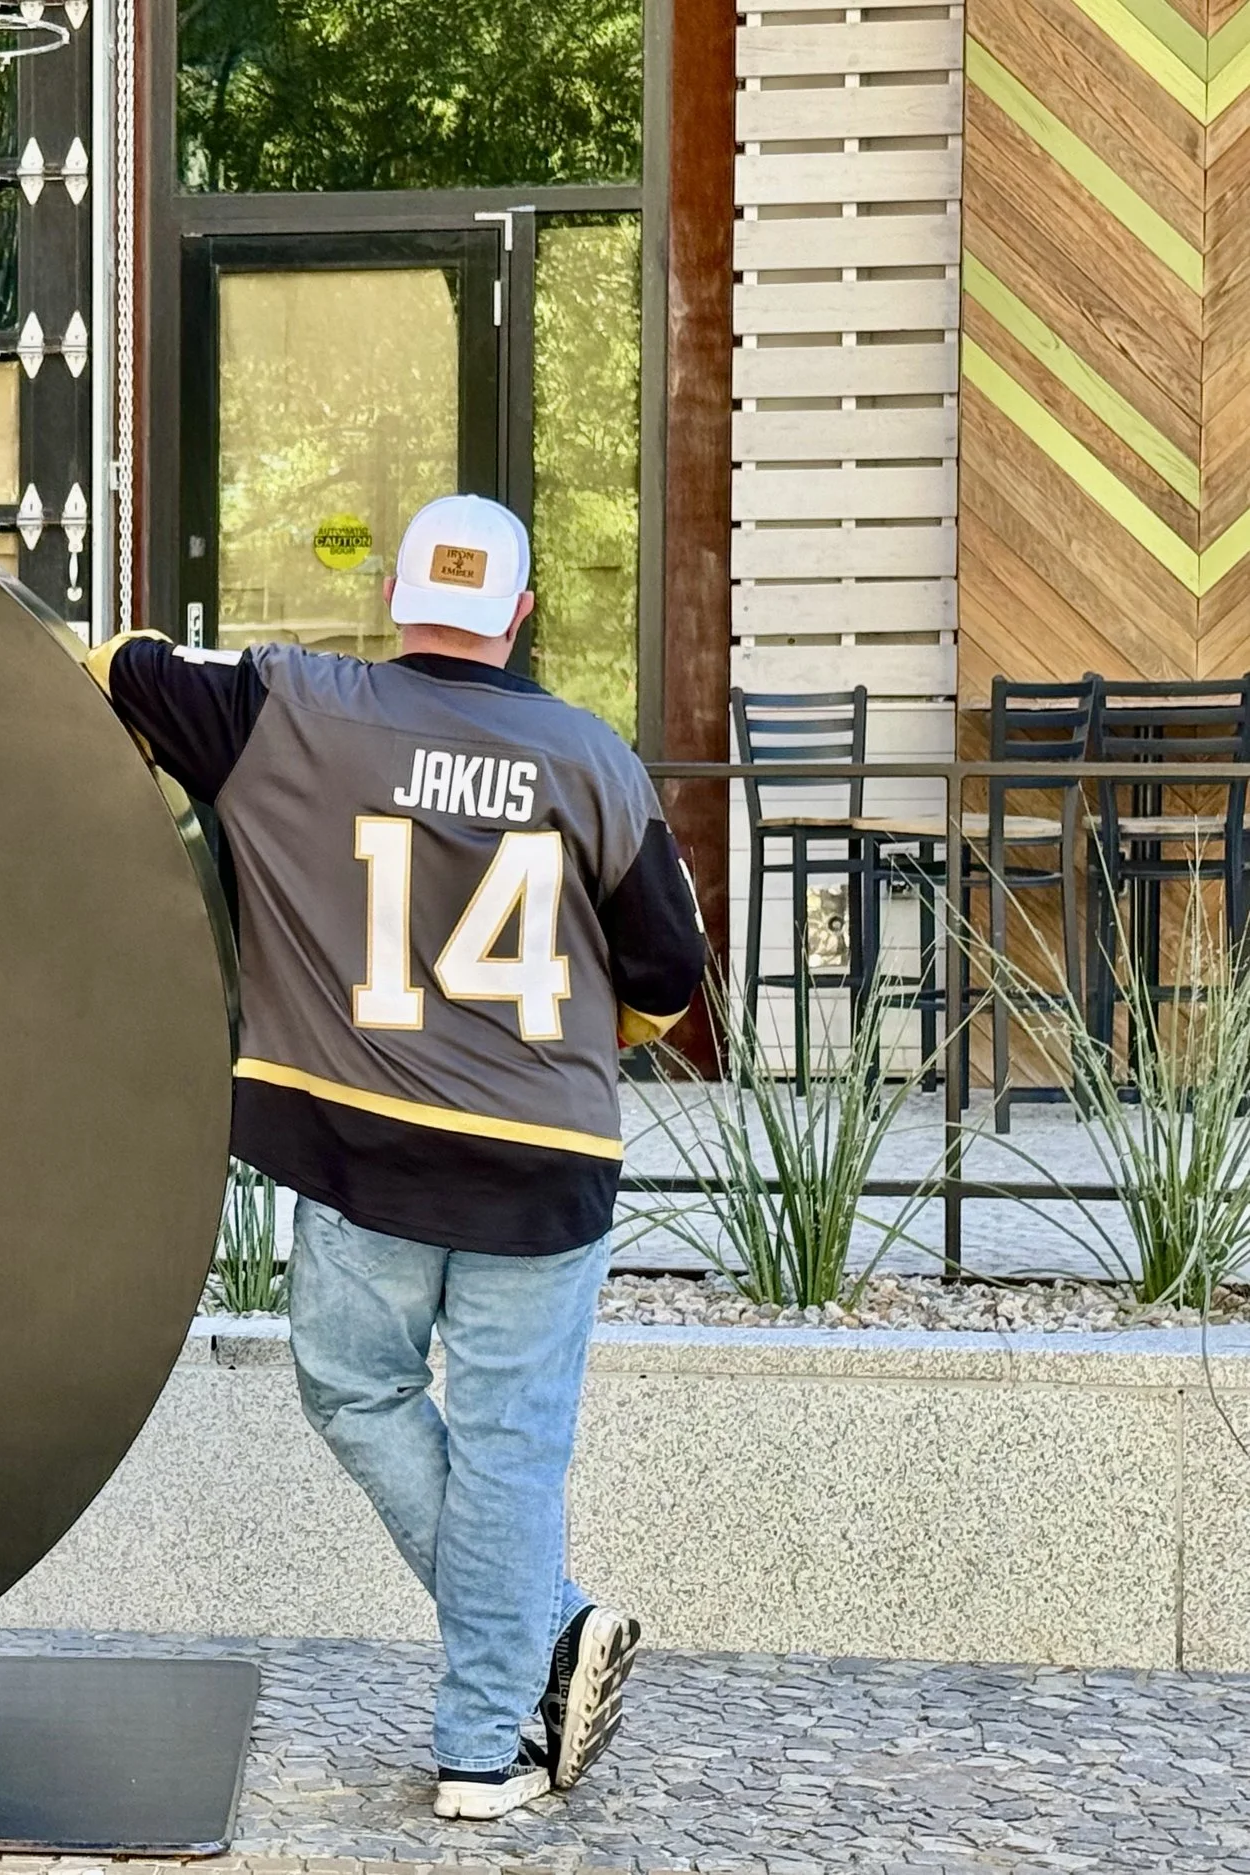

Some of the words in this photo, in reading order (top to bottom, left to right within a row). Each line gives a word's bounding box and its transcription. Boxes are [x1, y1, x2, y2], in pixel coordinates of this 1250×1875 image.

[315, 536, 371, 547] CAUTION
[446, 549, 475, 561] IRON
[441, 565, 475, 578] EMBER
[392, 748, 538, 823] JAKUS
[352, 815, 572, 1042] 14
